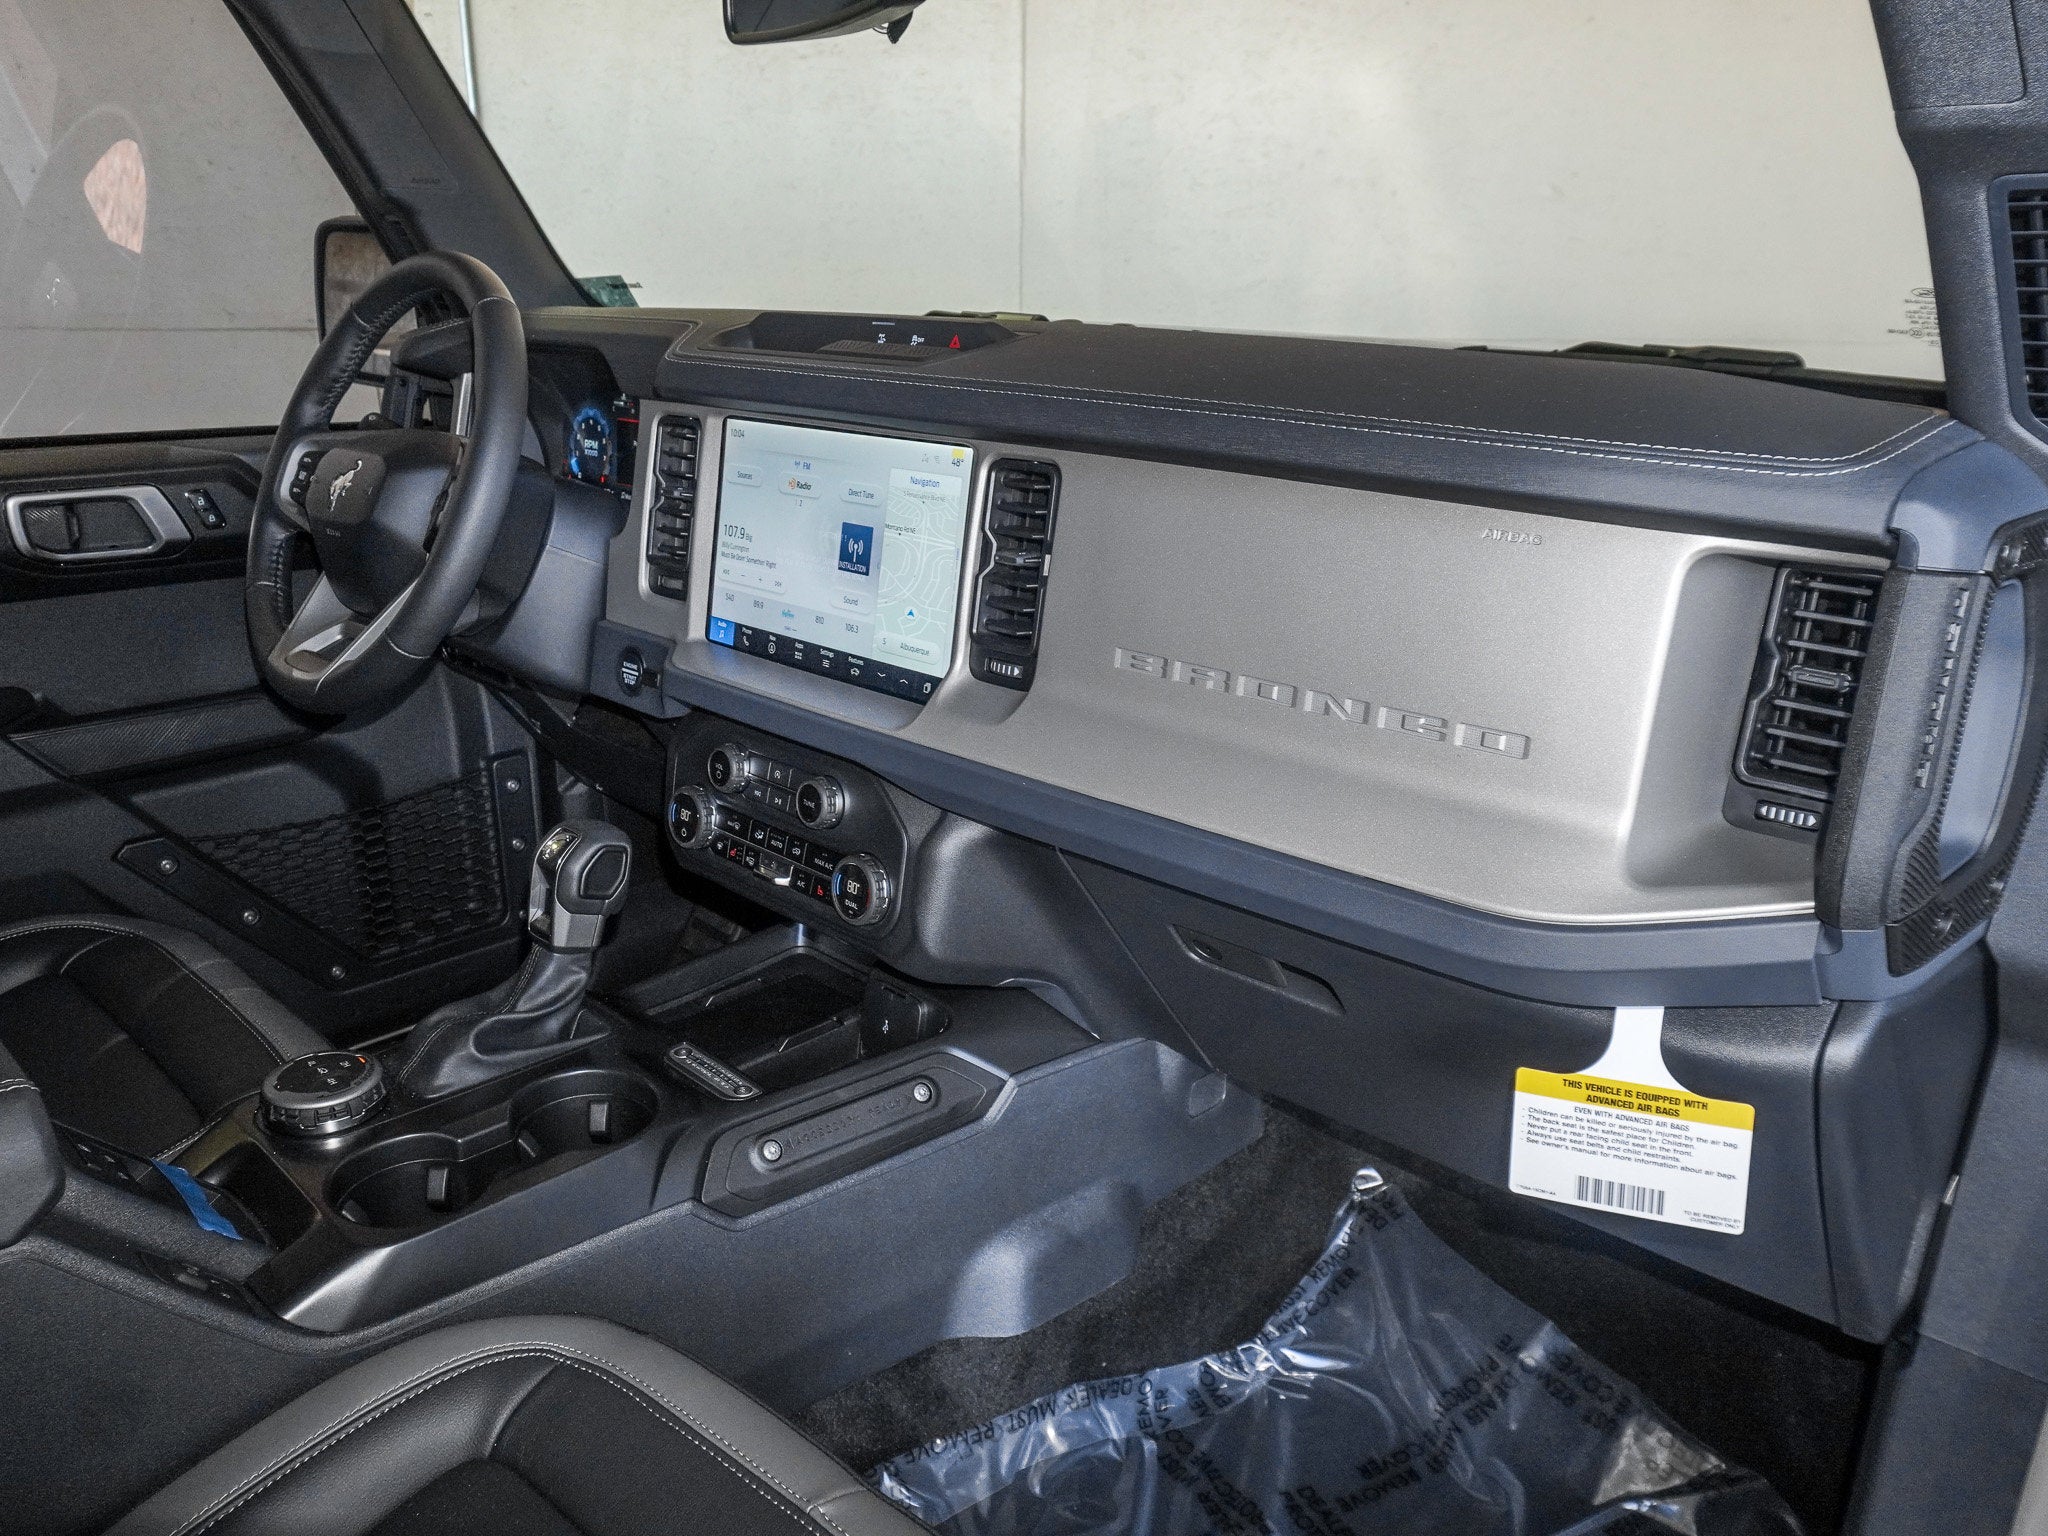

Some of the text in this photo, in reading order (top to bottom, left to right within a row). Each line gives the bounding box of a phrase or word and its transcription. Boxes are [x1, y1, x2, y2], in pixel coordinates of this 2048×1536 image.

[803, 462, 811, 470] FM
[796, 480, 812, 491] Radio
[910, 476, 940, 488] Navigation
[862, 490, 875, 500] Tune
[724, 524, 746, 540] 107.9
[1482, 528, 1543, 546] AIRBAG
[843, 595, 859, 606] Sound
[1114, 646, 1531, 760] BRONCO
[1563, 1078, 1709, 1111] THIS VEHICLE IS EQUIPPED WITH
[1586, 1094, 1680, 1118] ADVANCED AIR BAGS
[1528, 1106, 1558, 1118] Children
[1575, 1115, 1584, 1123] be
[1586, 1117, 1606, 1127] killed
[1618, 1124, 1653, 1135] seriously
[1655, 1129, 1682, 1140] injured
[1684, 1133, 1693, 1142] by
[1696, 1136, 1709, 1144] the
[1543, 1117, 1560, 1126] back
[1561, 1121, 1577, 1129] seat
[1587, 1125, 1600, 1133] the
[1601, 1128, 1624, 1137] safest
[1626, 1132, 1647, 1141] place
[1574, 1106, 1690, 1132] EVEN WITH ADVANCED AIR BAGS
[1527, 1122, 1548, 1131] Never
[1586, 1133, 1609, 1143] facing
[1611, 1137, 1630, 1146] child
[1631, 1141, 1648, 1149] seat
[1527, 1129, 1552, 1140] Always
[1569, 1138, 1585, 1146] seat
[1586, 1141, 1604, 1149] belts
[1526, 1137, 1540, 1145] See
[1571, 1146, 1598, 1156] manual
[1612, 1154, 1632, 1162] more
[1634, 1158, 1679, 1170] information
[1680, 1165, 1702, 1174] about
[1006, 1397, 1057, 1434] MUST
